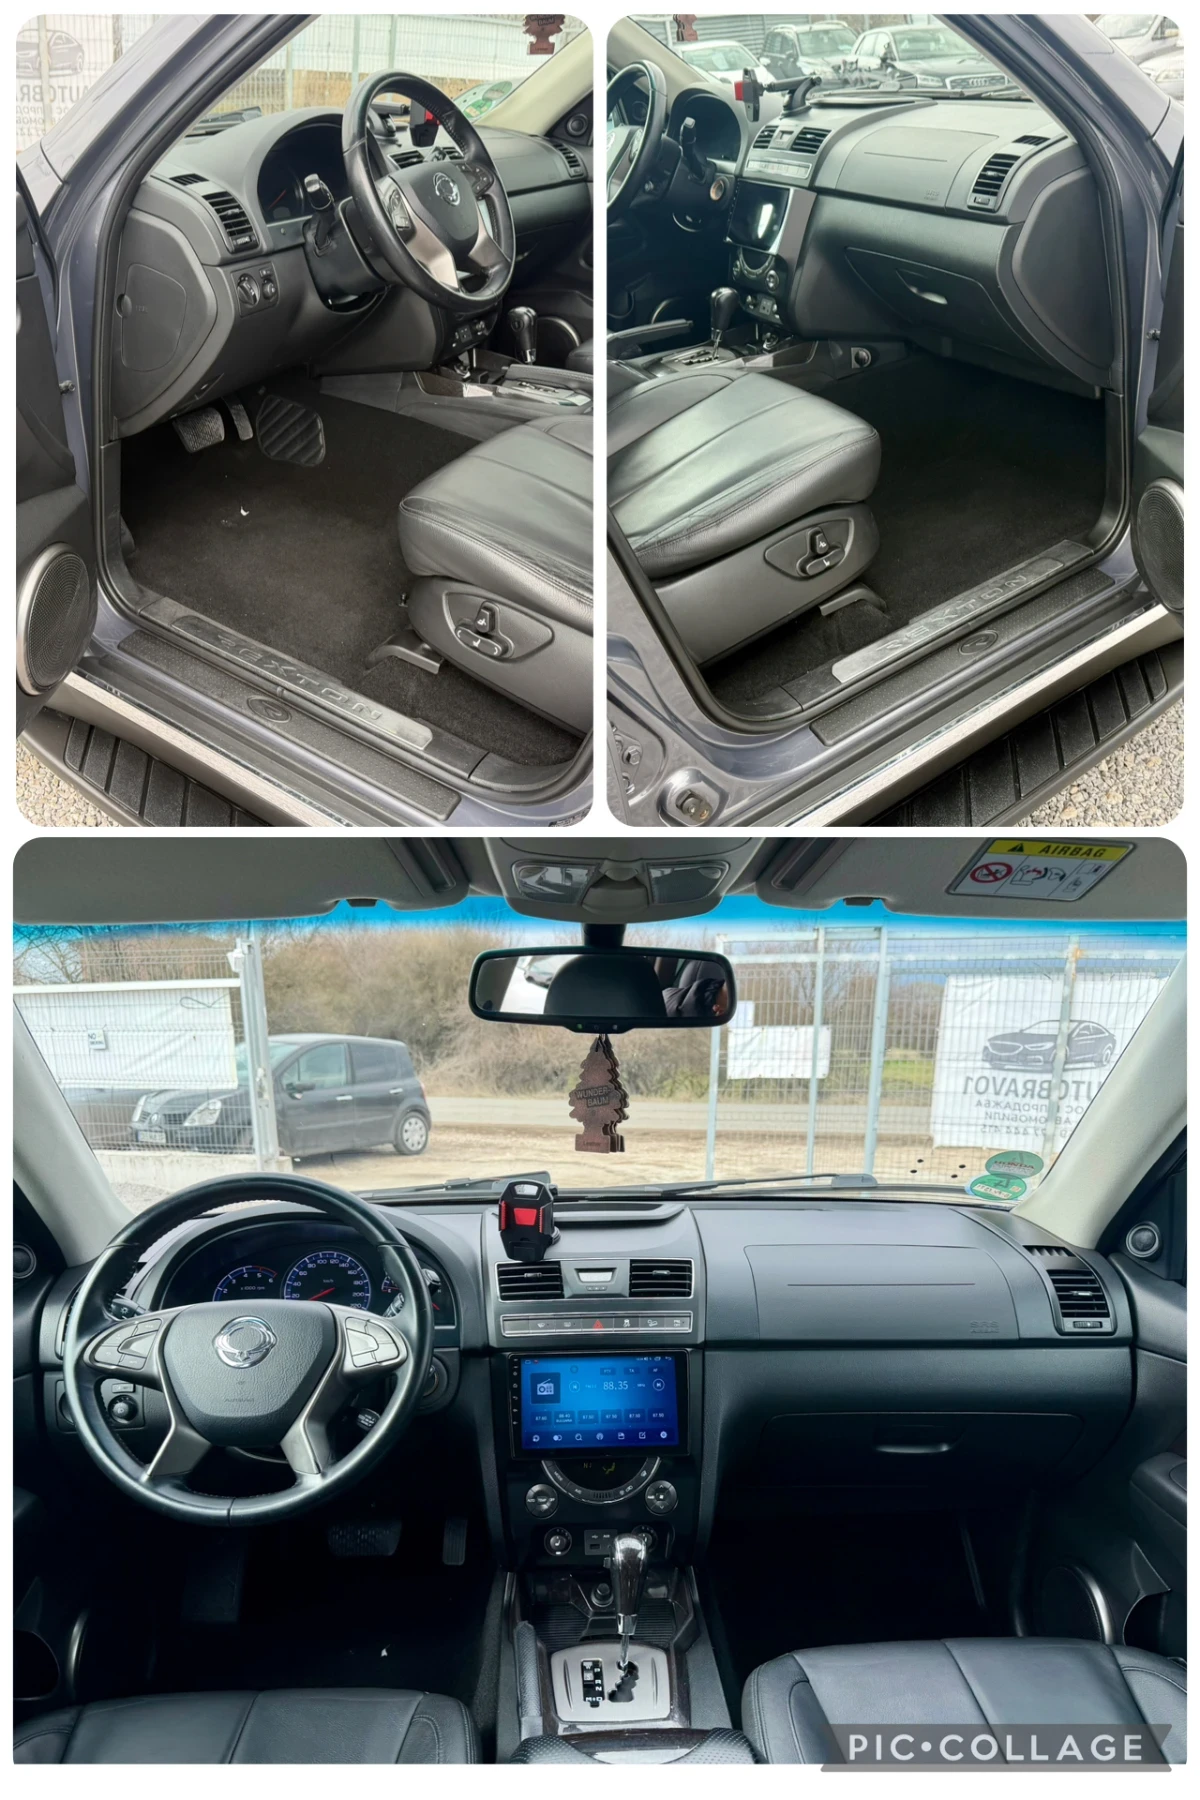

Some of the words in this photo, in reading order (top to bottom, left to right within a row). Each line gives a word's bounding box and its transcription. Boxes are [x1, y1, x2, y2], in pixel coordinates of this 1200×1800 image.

[876, 575, 1027, 651] REXTON
[1038, 844, 1107, 858] AIRBAG
[603, 1381, 629, 1391] 88.35
